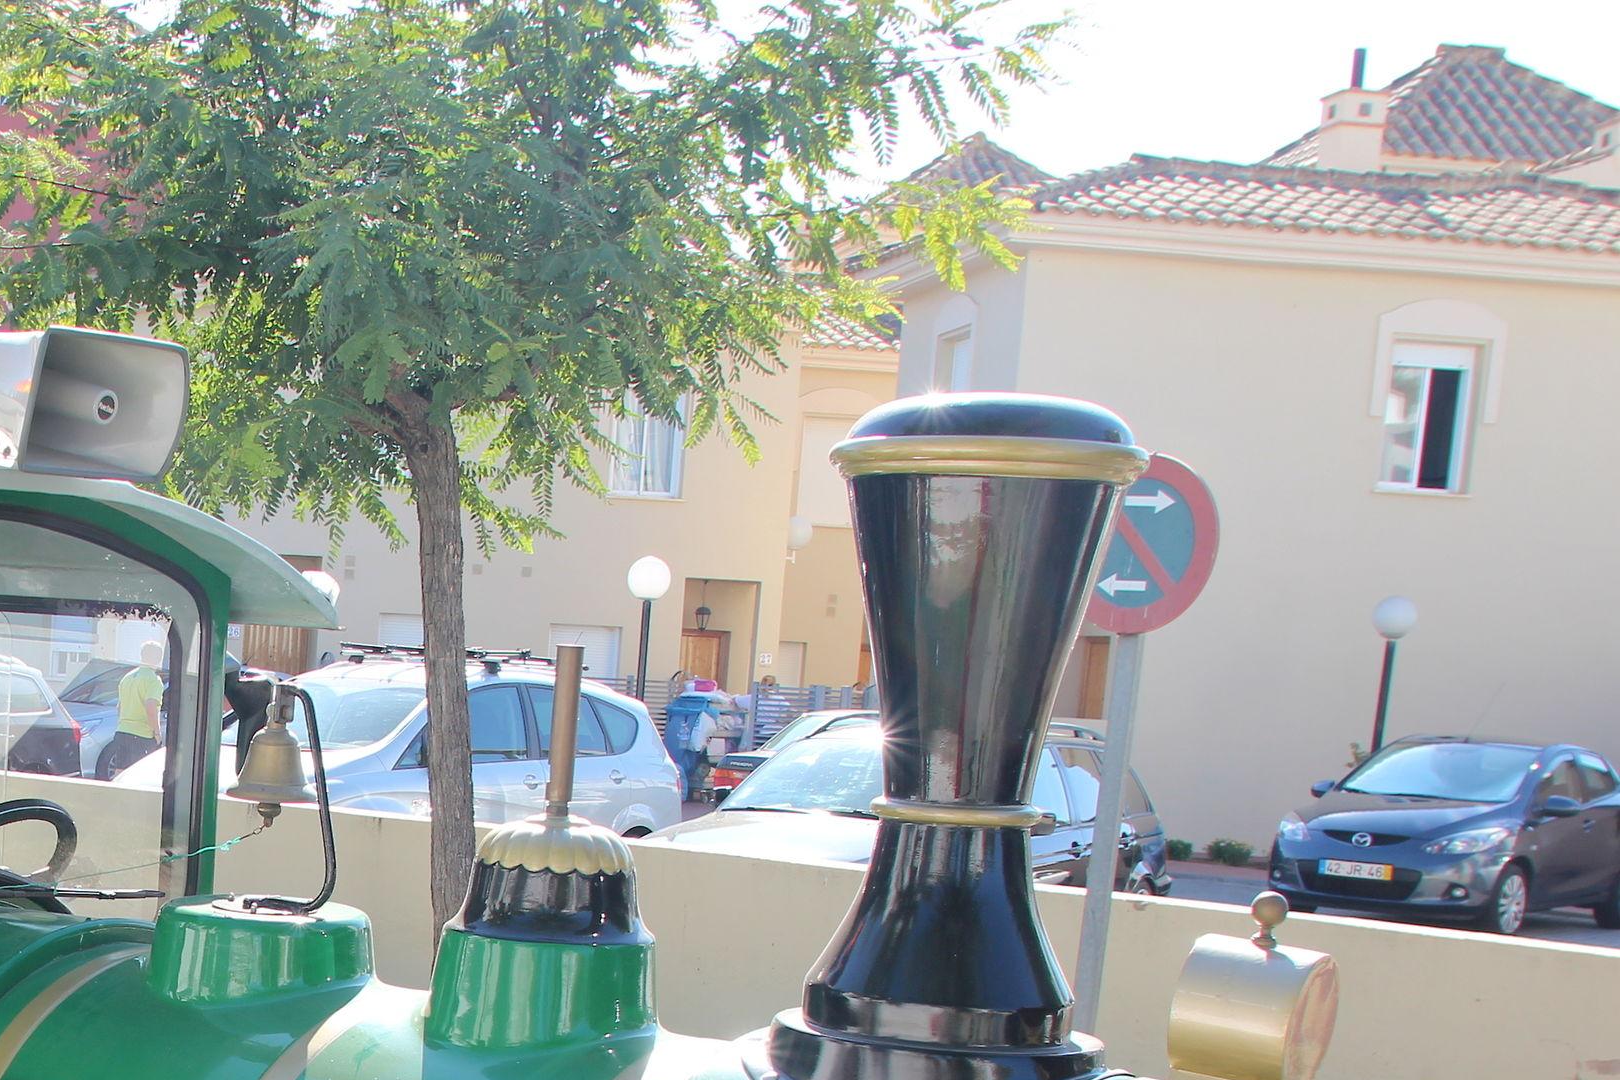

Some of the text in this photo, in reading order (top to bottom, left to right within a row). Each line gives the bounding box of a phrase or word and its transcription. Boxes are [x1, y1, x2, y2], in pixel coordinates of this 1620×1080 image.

[760, 654, 772, 664] 27
[1326, 862, 1383, 878] 42 JR 46
